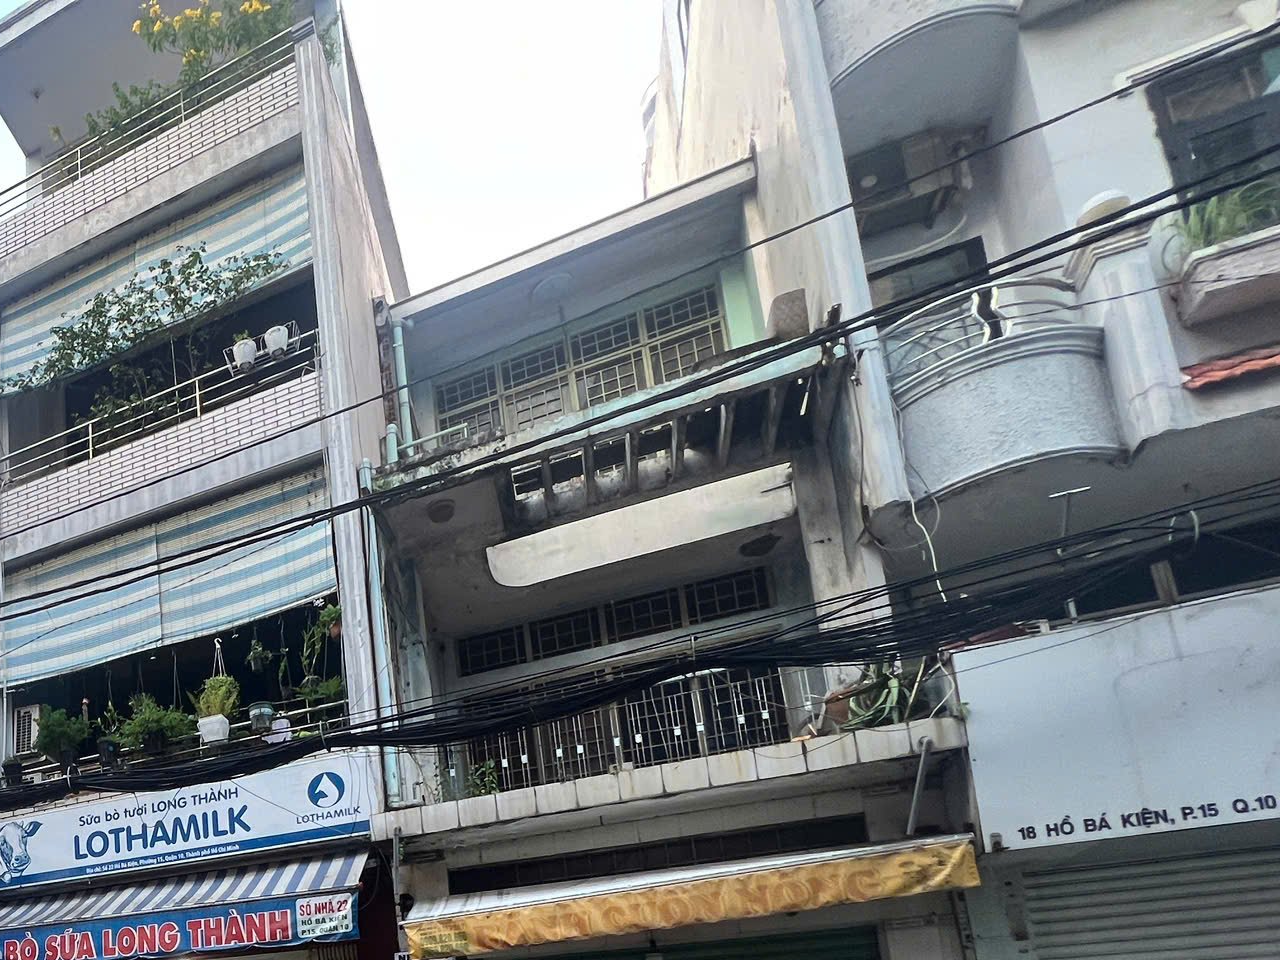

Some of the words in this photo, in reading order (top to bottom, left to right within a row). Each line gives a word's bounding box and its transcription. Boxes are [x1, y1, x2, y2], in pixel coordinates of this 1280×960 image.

[105, 809, 120, 821] bò
[124, 803, 147, 818] tươi
[152, 797, 187, 813] LONG
[191, 787, 239, 806] THÀNH
[296, 806, 361, 825] LOTHAMILK
[1018, 826, 1037, 841] 18
[1046, 815, 1075, 837] HỒ
[1083, 812, 1112, 833] BÁ
[1121, 808, 1176, 829] KIỆN,
[1181, 803, 1219, 821] P.15
[1232, 795, 1278, 814] Q.10
[74, 804, 251, 860] LOTHAMILK
[102, 922, 180, 958] LONG
[186, 909, 292, 950] THÀNH
